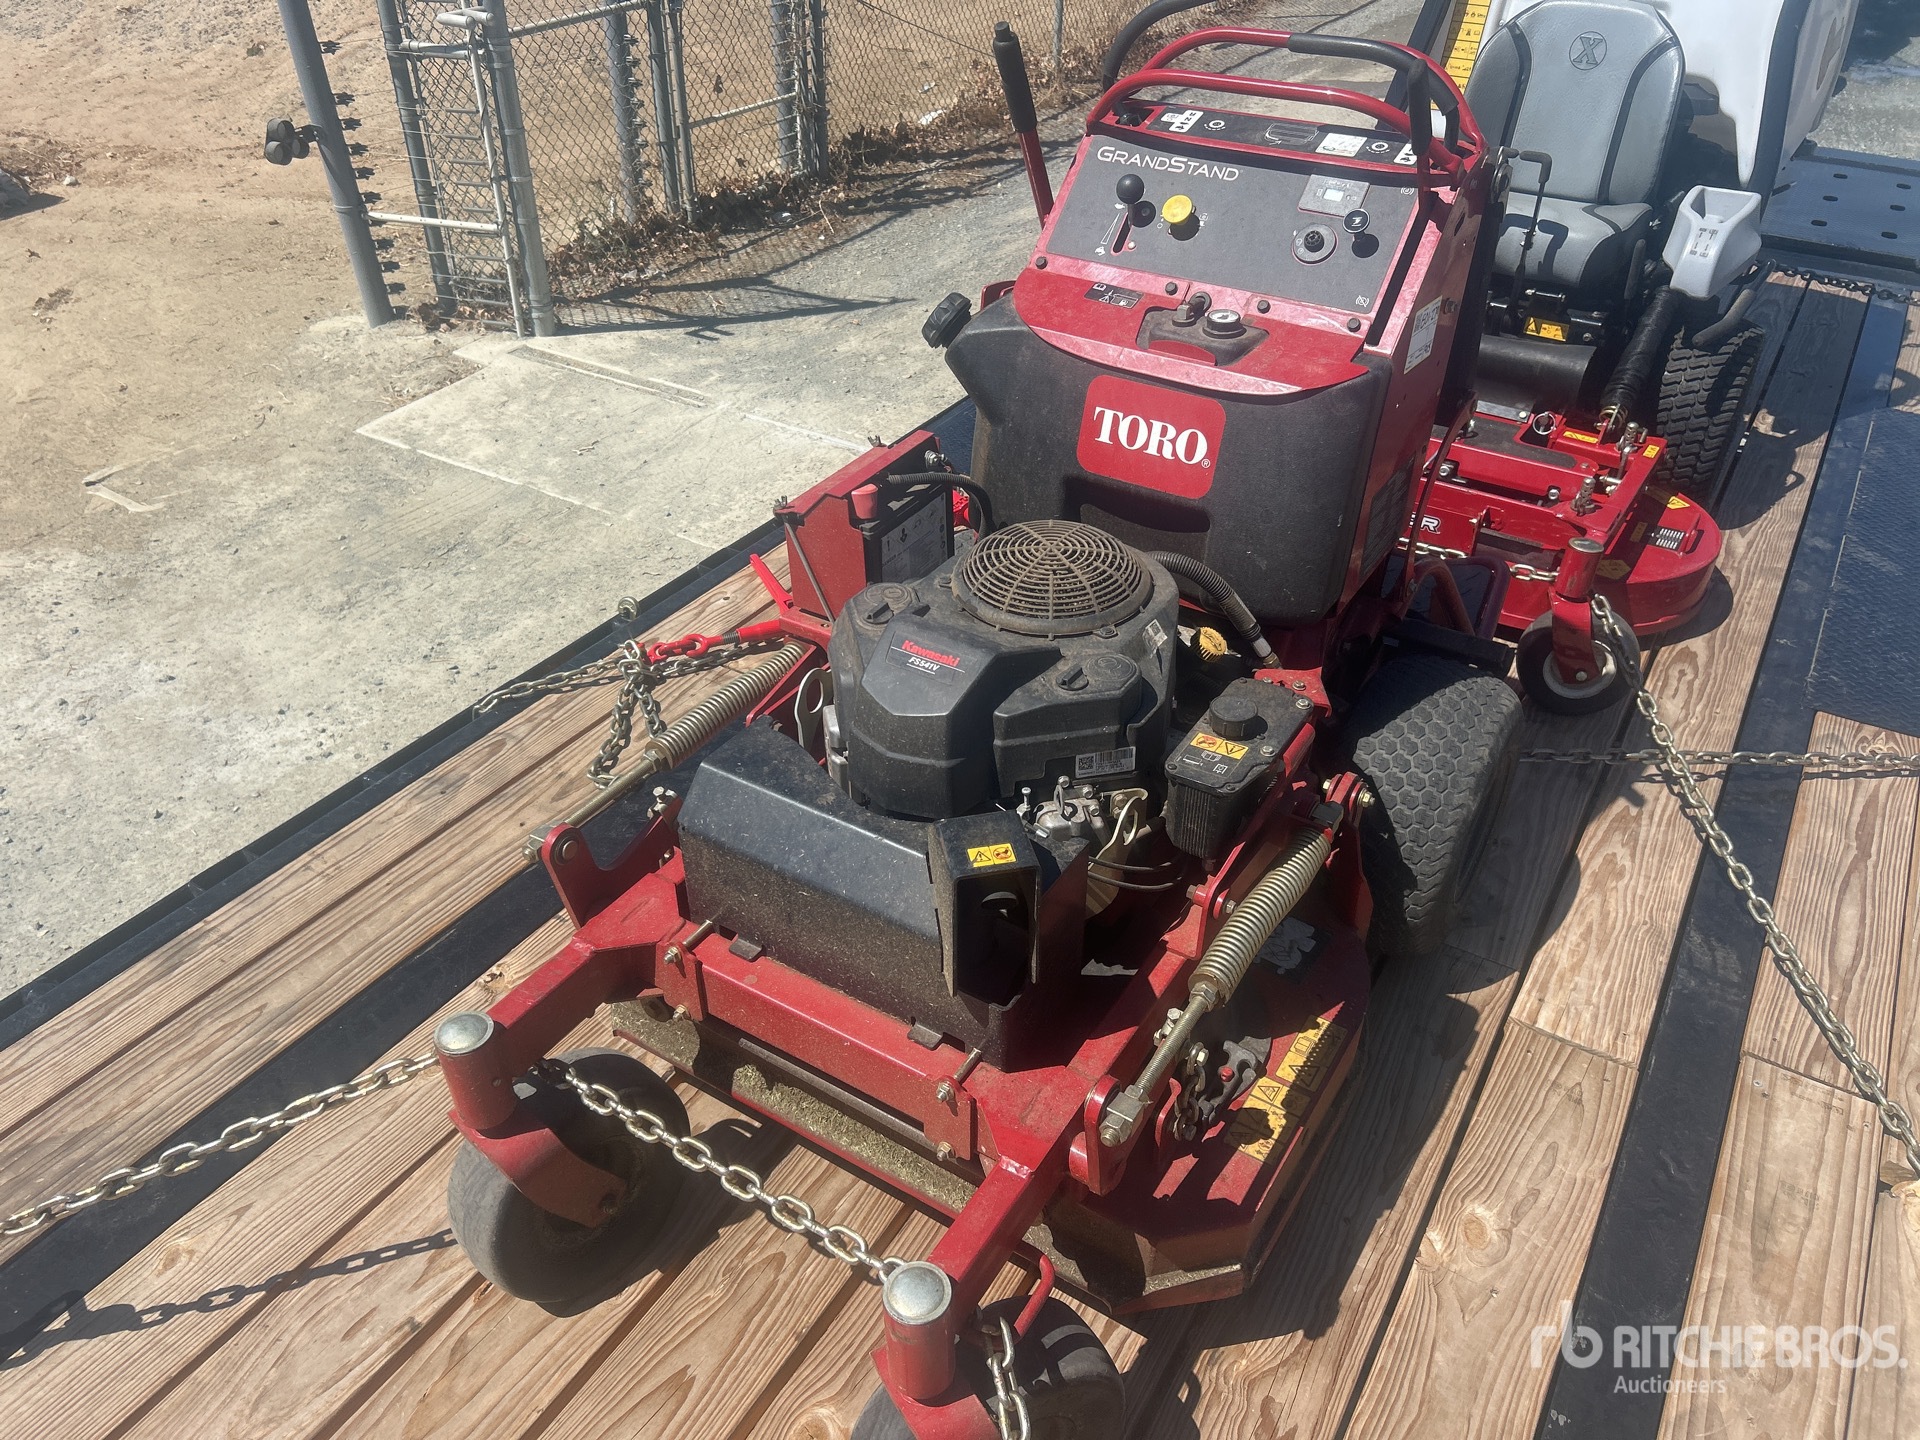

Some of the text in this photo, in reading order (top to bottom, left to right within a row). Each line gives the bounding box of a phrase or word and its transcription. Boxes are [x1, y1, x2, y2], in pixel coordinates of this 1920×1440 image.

[1093, 406, 1208, 465] TORO
[902, 640, 960, 667] Kawasaki
[908, 656, 940, 671] FS541V
